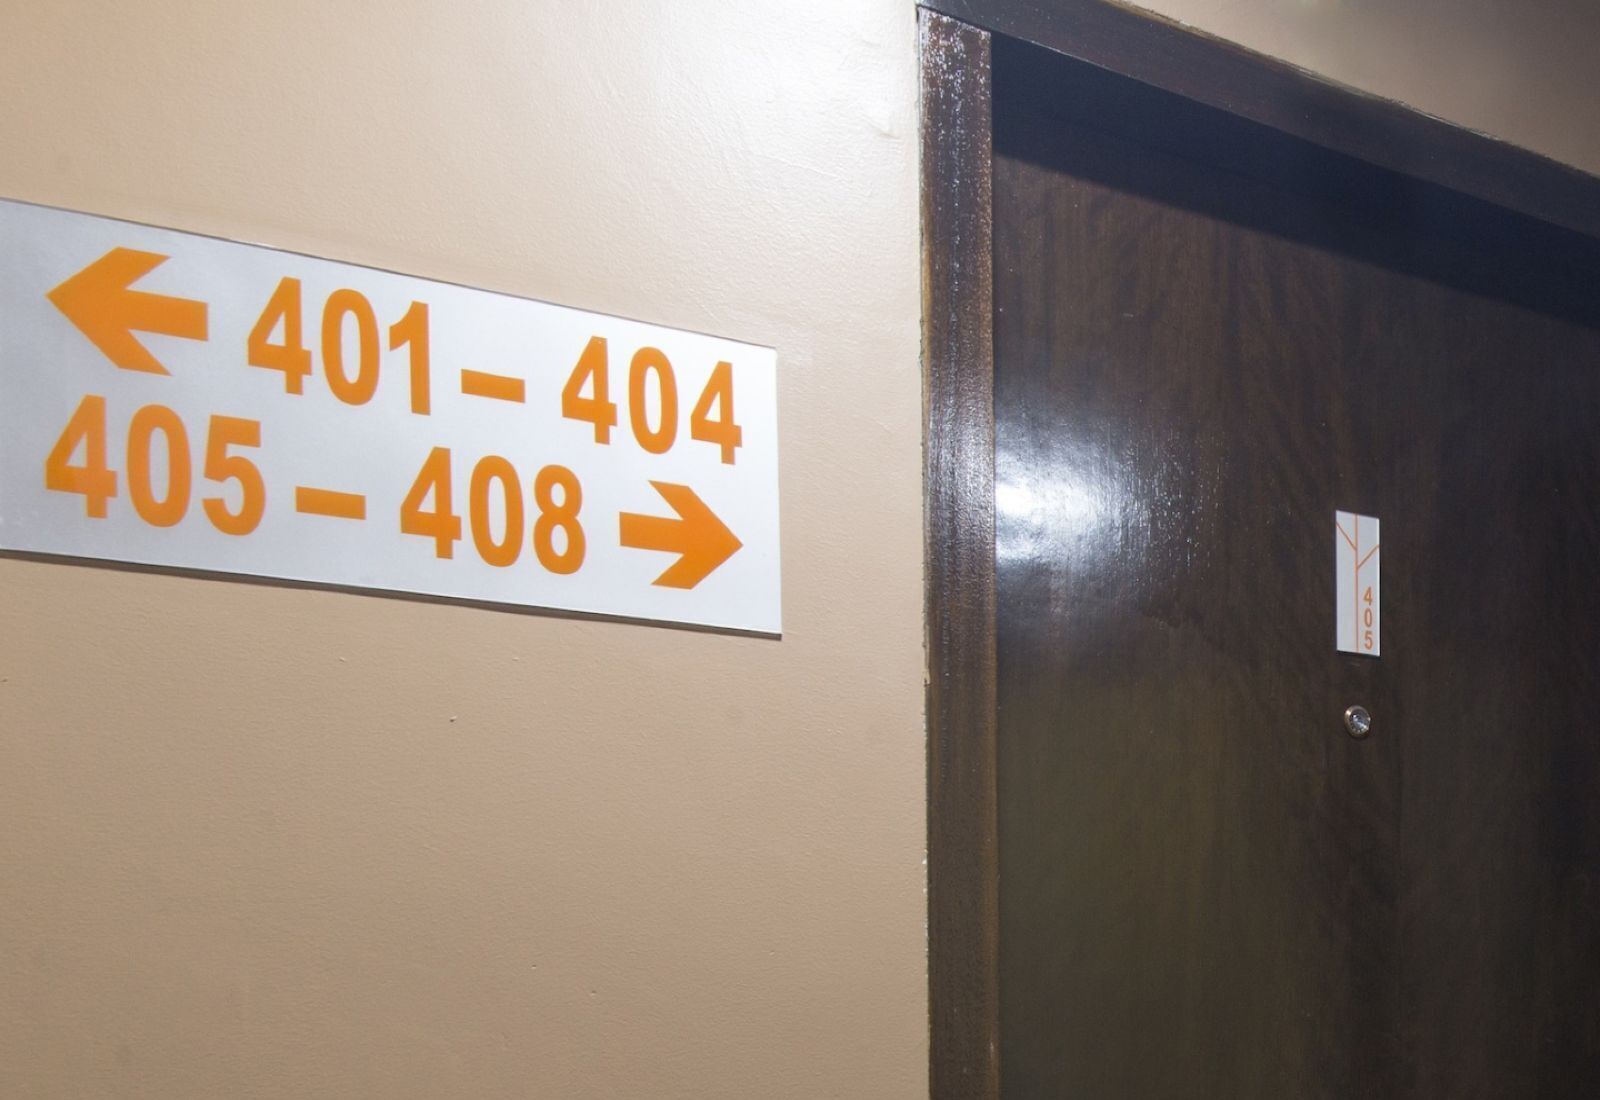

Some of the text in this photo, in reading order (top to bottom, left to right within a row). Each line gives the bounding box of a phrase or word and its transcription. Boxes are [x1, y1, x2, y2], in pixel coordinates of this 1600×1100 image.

[247, 276, 432, 416] 401
[561, 336, 742, 465] 404
[45, 395, 266, 536] 405
[400, 447, 586, 575] 408
[1363, 586, 1374, 650] 405
